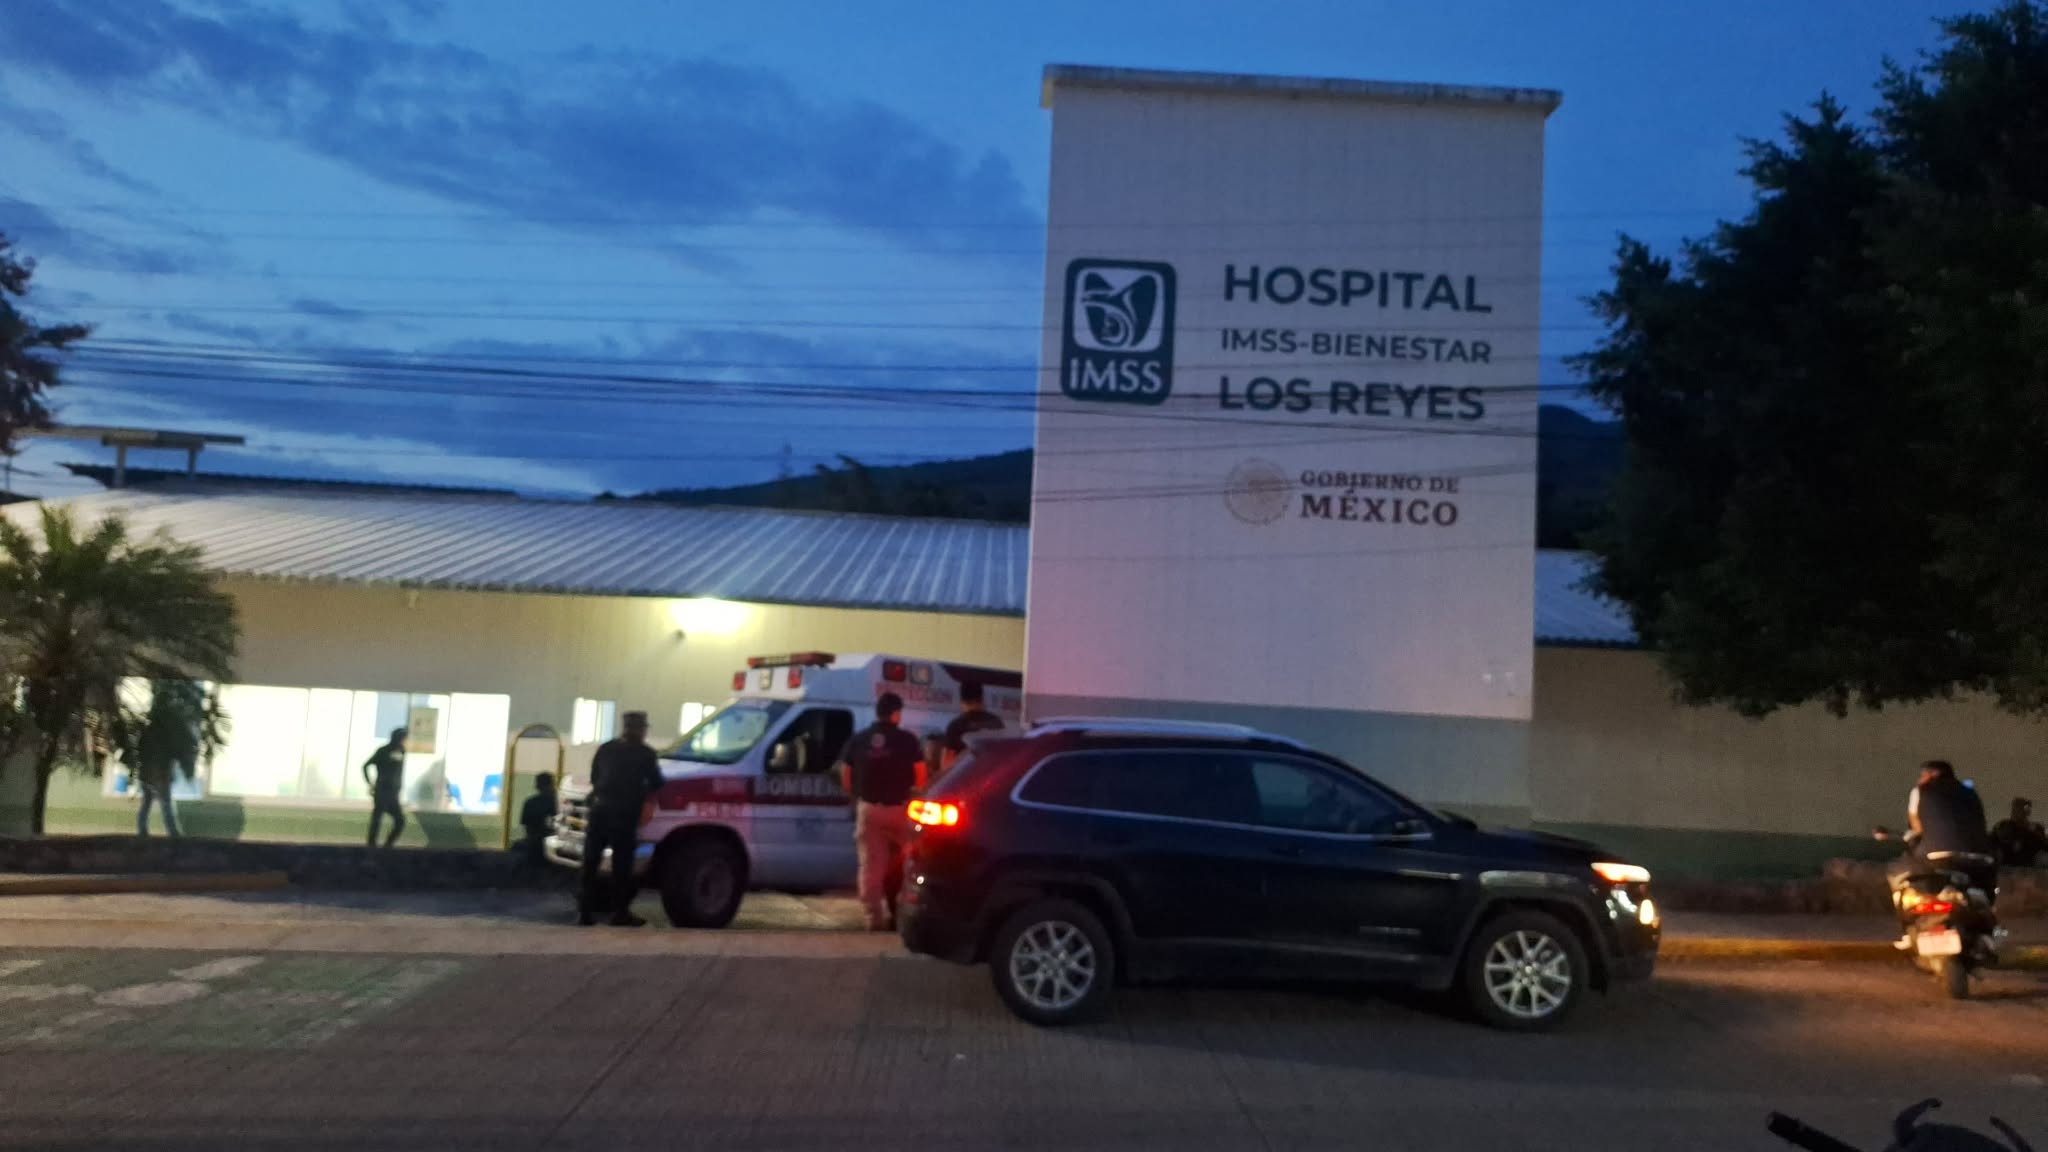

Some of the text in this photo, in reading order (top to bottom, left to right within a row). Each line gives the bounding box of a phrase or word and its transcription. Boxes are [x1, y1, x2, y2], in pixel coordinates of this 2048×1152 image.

[1224, 264, 1493, 314] HOSPITAL
[1221, 327, 1493, 364] IMSS-BIENESTAR
[1068, 357, 1163, 394] IMSS
[1219, 375, 1487, 421] LOS REYES
[1300, 469, 1460, 494] GOBIERNO DE
[1299, 488, 1459, 527] MÉXICO
